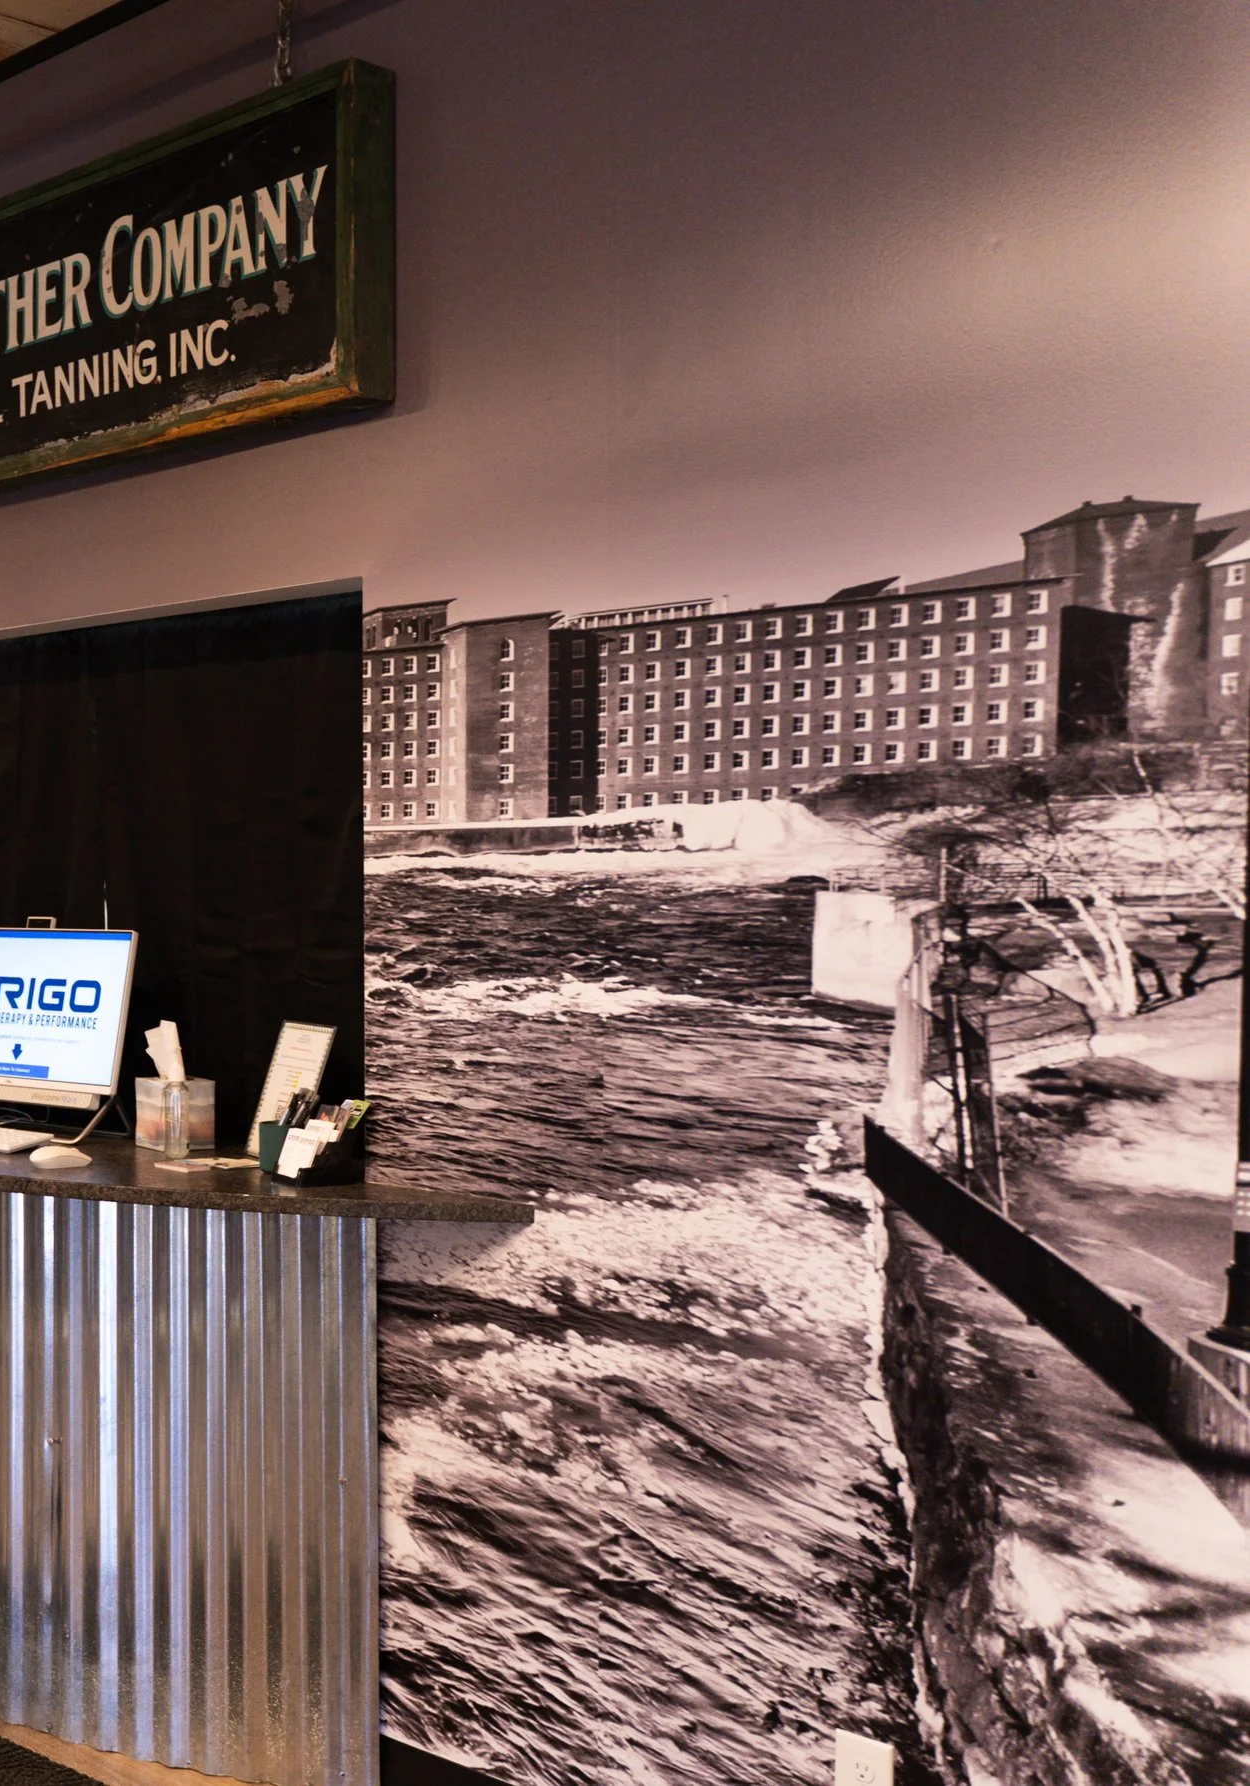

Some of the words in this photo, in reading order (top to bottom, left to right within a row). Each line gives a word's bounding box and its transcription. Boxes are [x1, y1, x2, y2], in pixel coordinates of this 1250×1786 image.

[100, 165, 328, 318] COMPANY
[170, 319, 236, 378] INC.
[28, 1014, 34, 1026] &
[35, 1014, 98, 1030] PERFORMANCE
